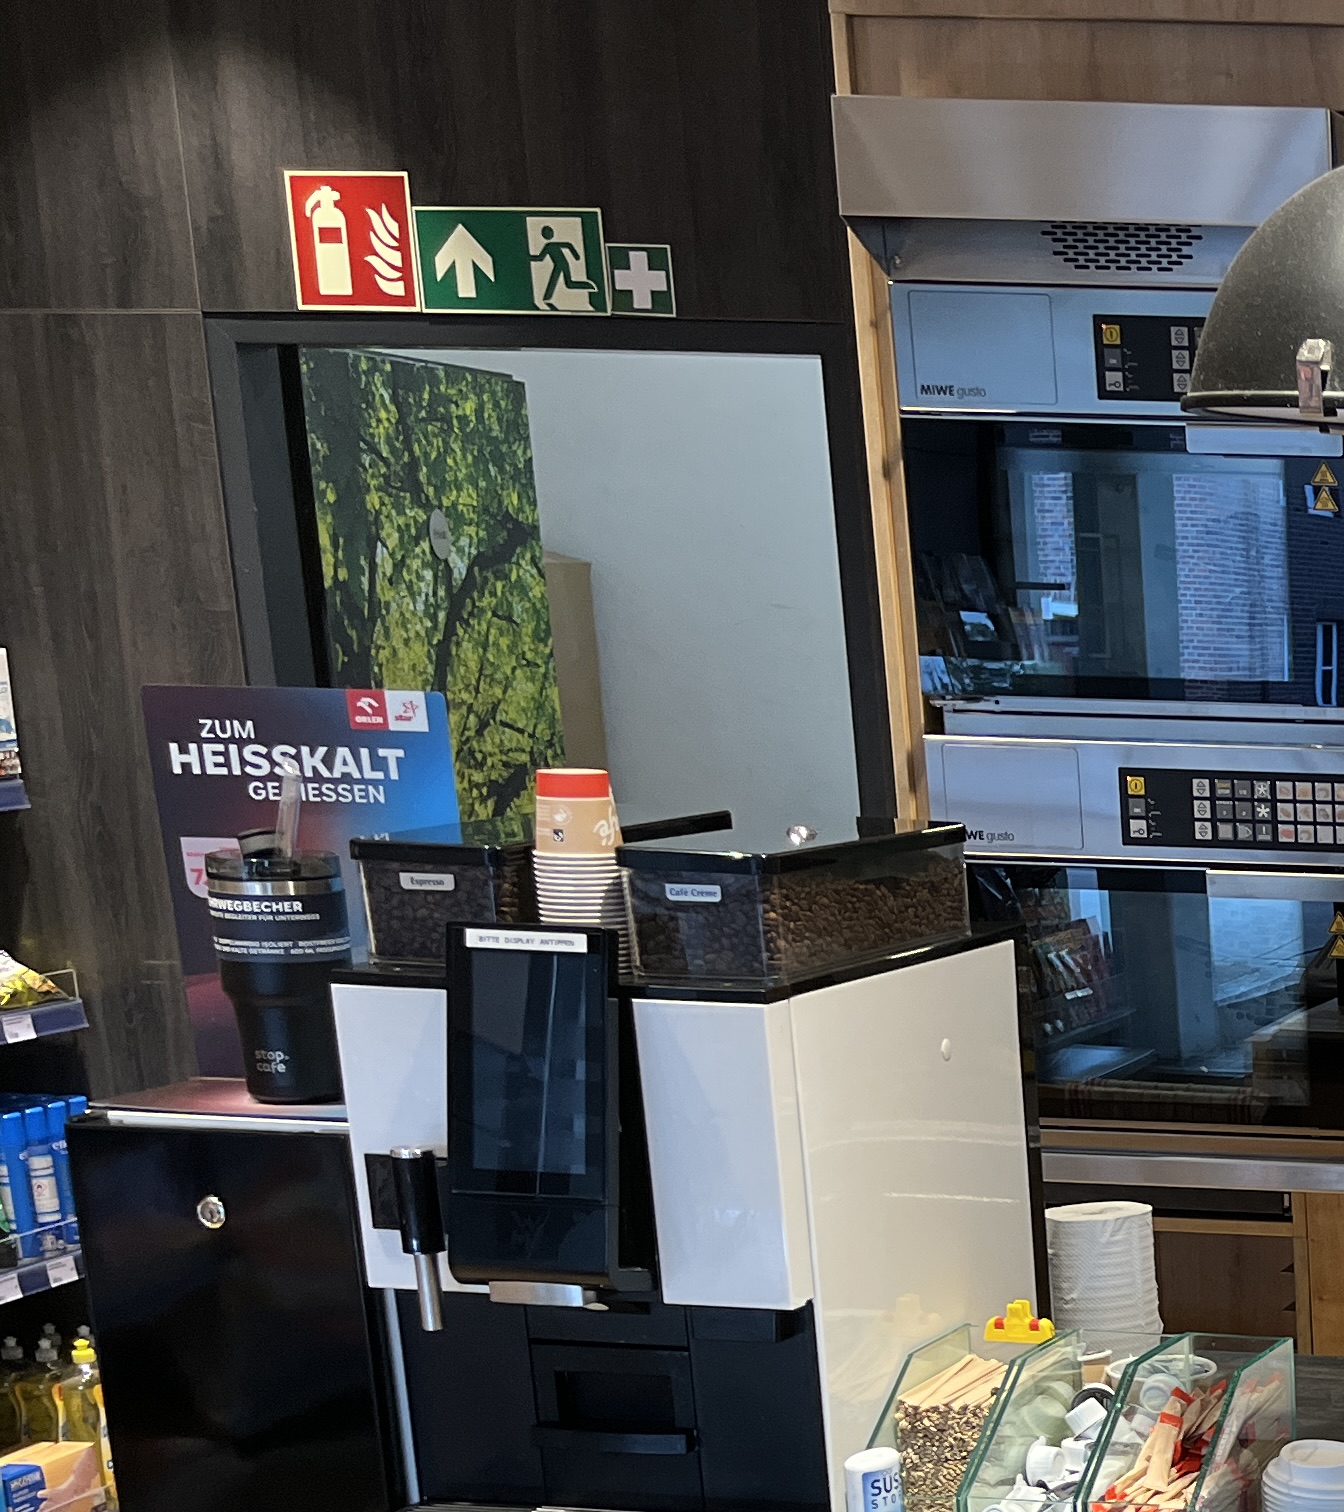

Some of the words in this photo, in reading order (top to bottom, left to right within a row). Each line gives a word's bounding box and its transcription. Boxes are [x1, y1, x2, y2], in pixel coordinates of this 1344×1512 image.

[920, 384, 955, 398] MIWE
[956, 386, 987, 400] gusto
[199, 719, 255, 739] ZUM
[168, 743, 405, 781] HEISSKALT
[248, 781, 386, 804] GEIESSEN
